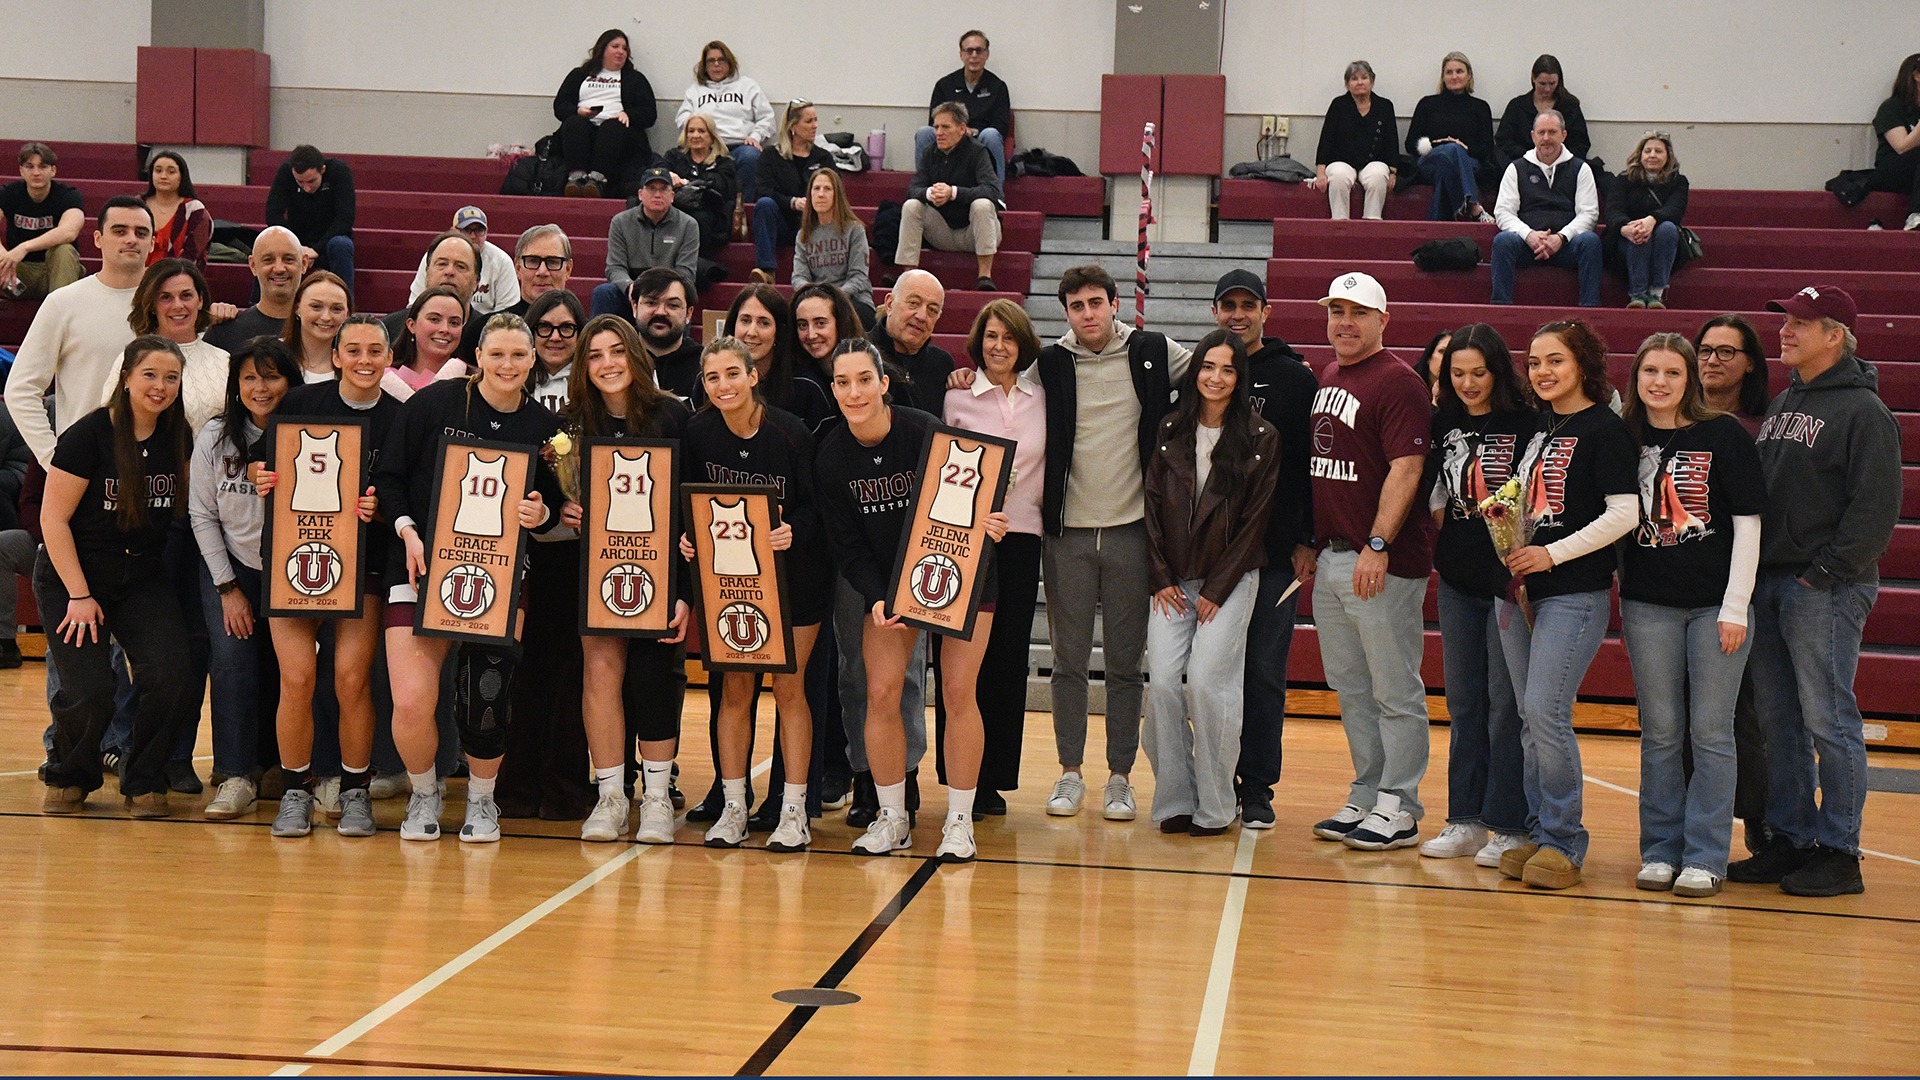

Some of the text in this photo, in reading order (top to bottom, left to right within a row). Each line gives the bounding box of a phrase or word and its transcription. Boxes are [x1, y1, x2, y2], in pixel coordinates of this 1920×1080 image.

[698, 93, 744, 108] UNION
[14, 213, 54, 230] UNION
[805, 237, 848, 256] UNION
[310, 452, 328, 474] 5
[615, 474, 647, 495] 31
[943, 464, 976, 490] 22
[468, 475, 499, 498] 10
[297, 515, 334, 527] KATE
[299, 528, 332, 540] PEEK
[715, 521, 748, 540] 23
[926, 525, 970, 544] JELENA
[453, 536, 498, 552] GRACE
[608, 535, 650, 548] GRACE
[920, 536, 971, 559] PEROVIC
[439, 548, 509, 567] CESERETTI
[600, 548, 658, 561] ARCOLEO
[720, 576, 760, 589] GRACE
[288, 597, 309, 606] 2025
[316, 598, 338, 606] 2026
[719, 589, 764, 601] ARDITO
[908, 605, 927, 617] 2025
[932, 612, 952, 623] 2026
[440, 619, 461, 628] 2025
[468, 621, 490, 631] 2026
